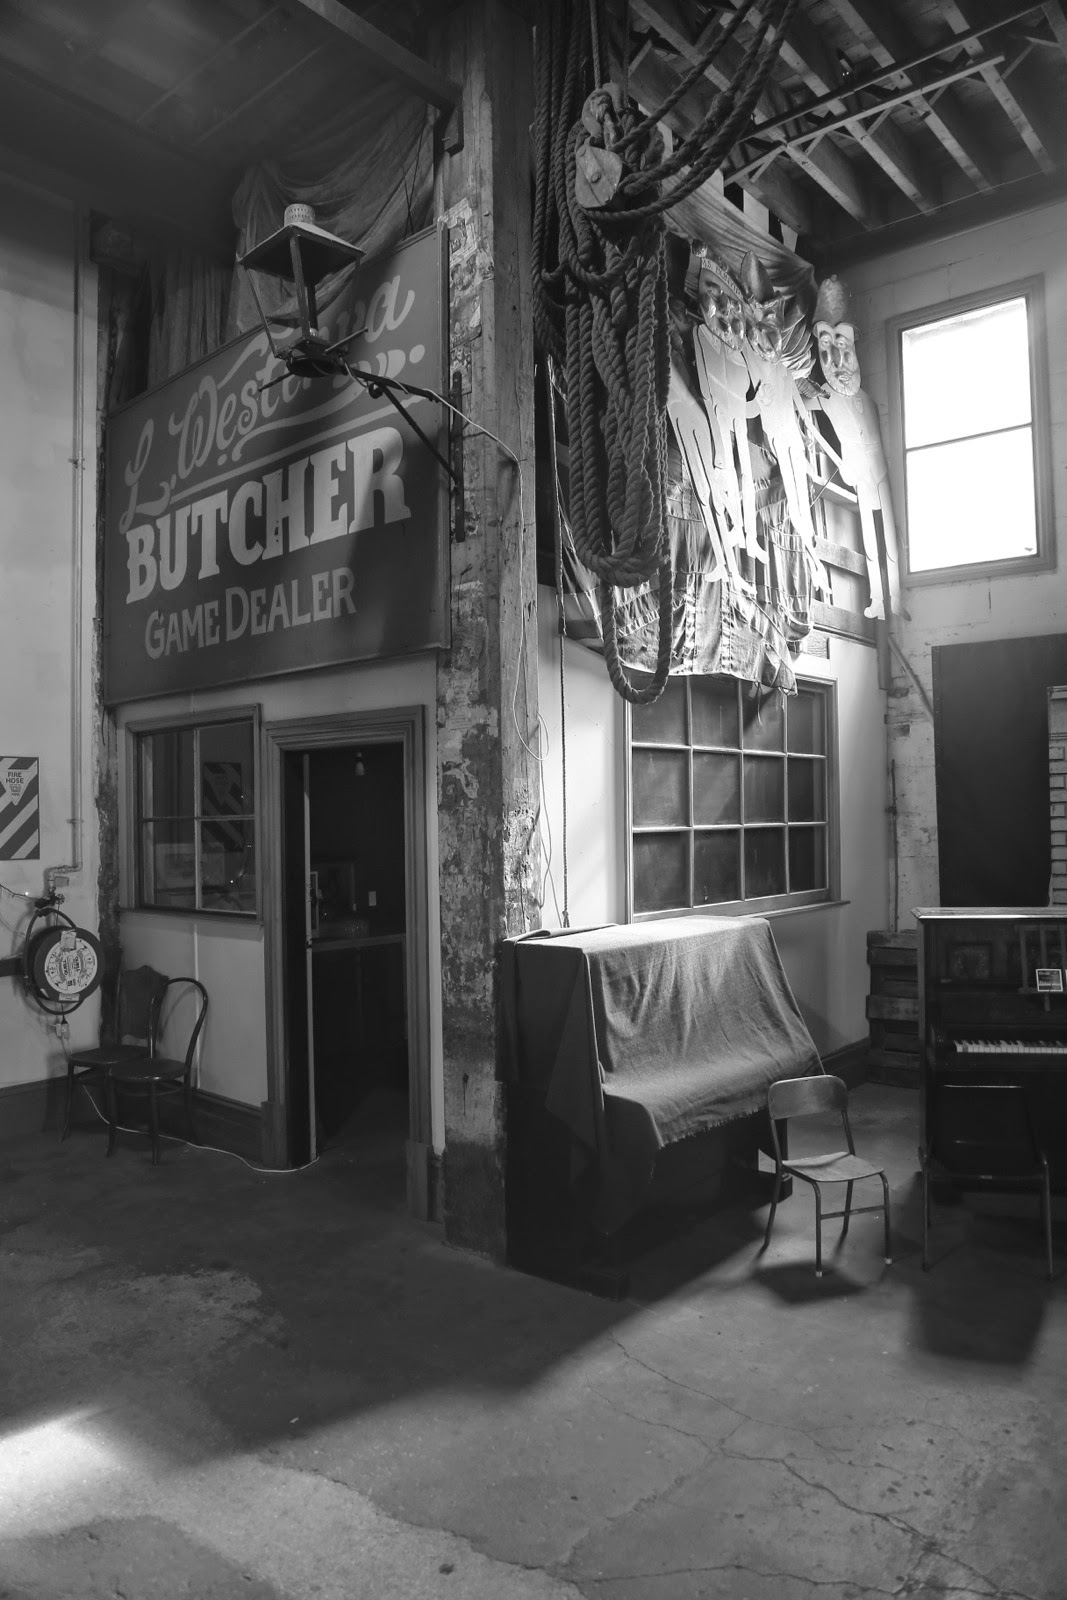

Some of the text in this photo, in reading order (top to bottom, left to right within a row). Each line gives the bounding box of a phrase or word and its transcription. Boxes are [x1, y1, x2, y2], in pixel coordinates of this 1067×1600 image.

[126, 426, 412, 605] BUTCHER
[145, 566, 357, 660] GAME DEALER
